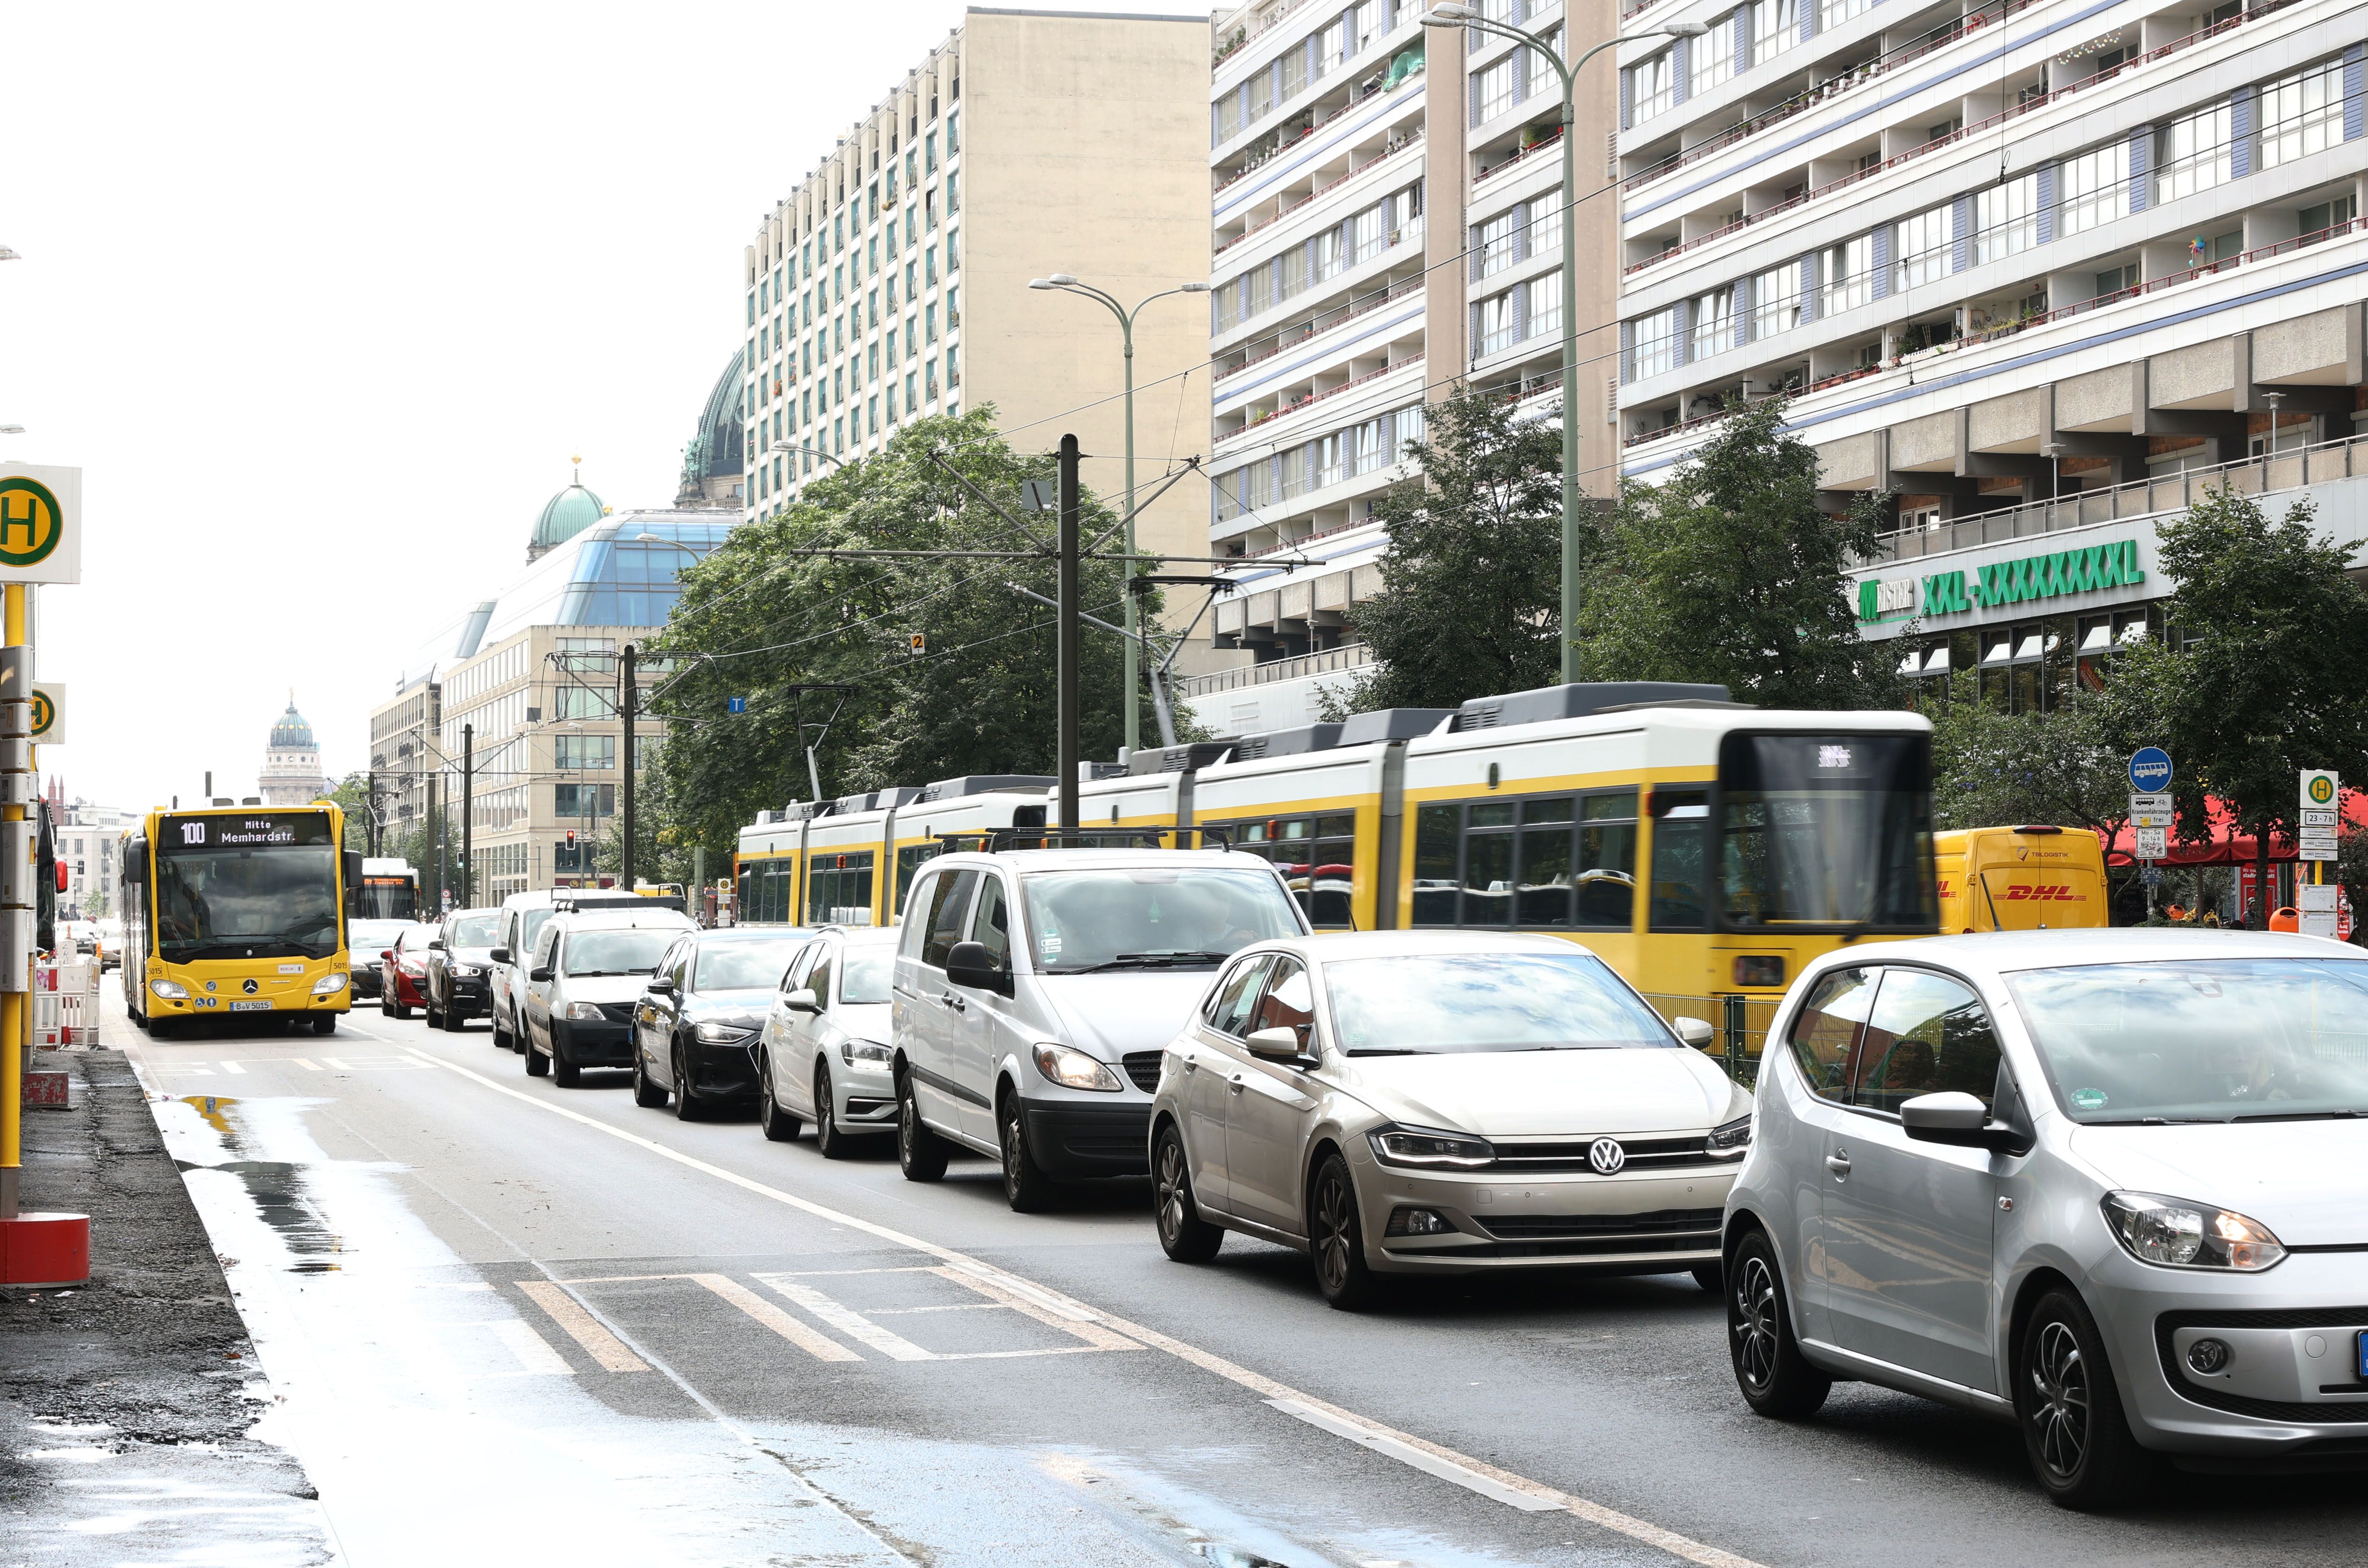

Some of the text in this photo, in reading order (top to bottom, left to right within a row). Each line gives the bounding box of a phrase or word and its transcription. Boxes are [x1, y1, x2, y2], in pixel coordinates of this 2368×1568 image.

[0, 497, 37, 547] H
[913, 636, 923, 649] 2
[732, 698, 741, 711] T
[2316, 781, 2327, 798] H
[181, 821, 271, 843] 100 Mitte
[222, 832, 296, 843] Memhardstr.
[2006, 885, 2074, 900] DHL
